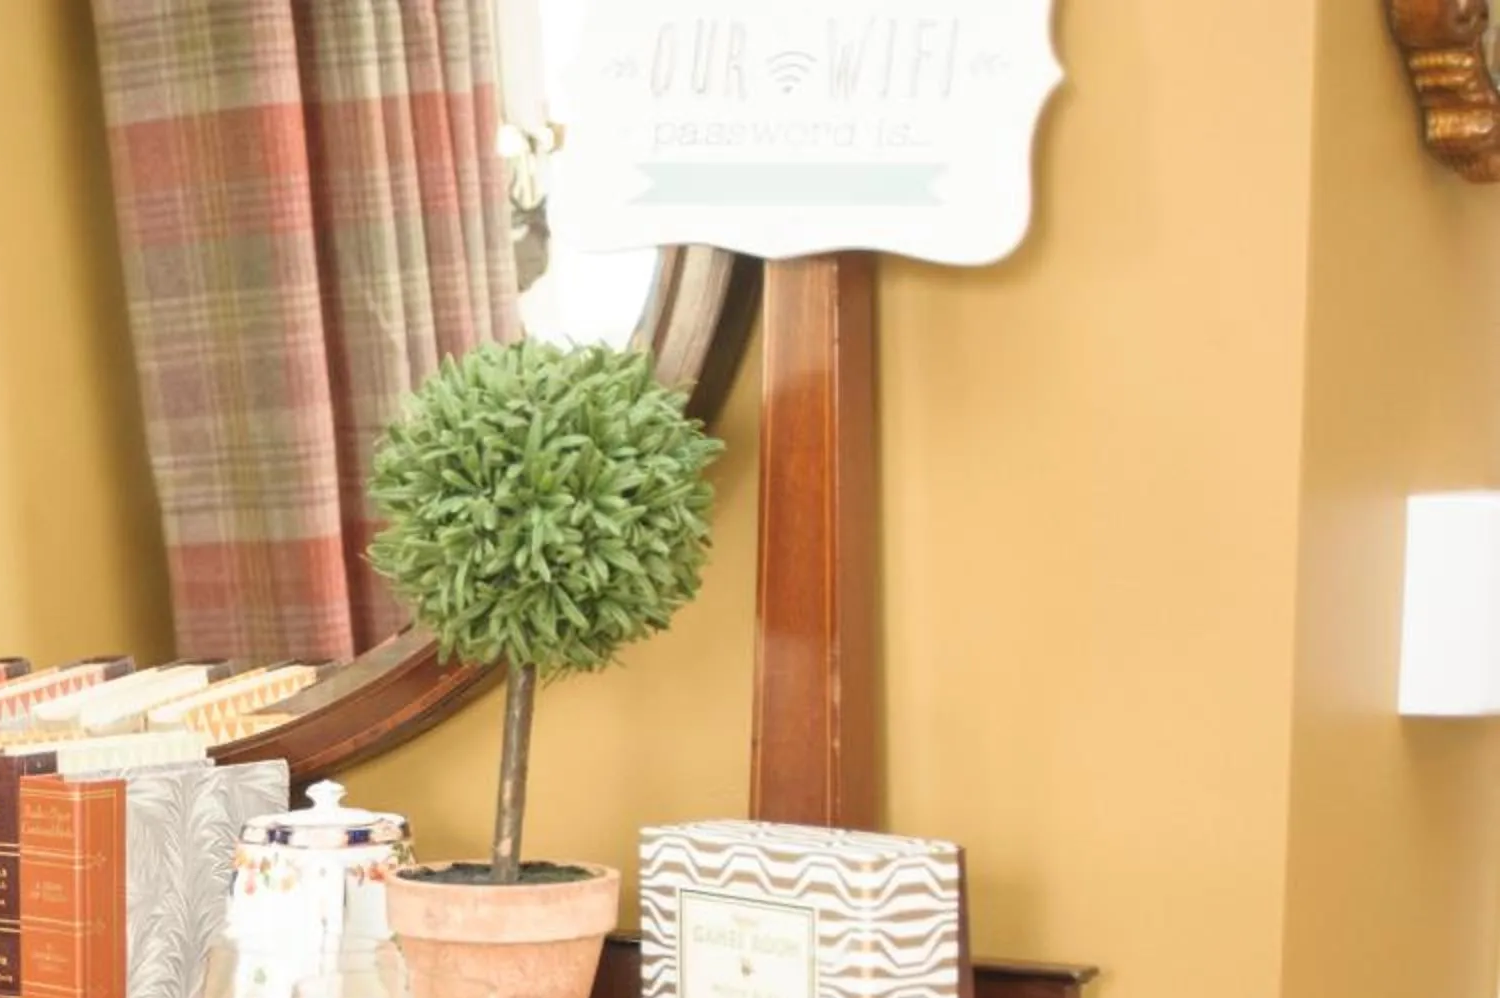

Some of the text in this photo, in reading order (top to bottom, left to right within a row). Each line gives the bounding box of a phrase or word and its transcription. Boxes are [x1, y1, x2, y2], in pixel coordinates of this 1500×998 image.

[649, 14, 961, 101] OUR WIFI
[652, 117, 857, 154] password
